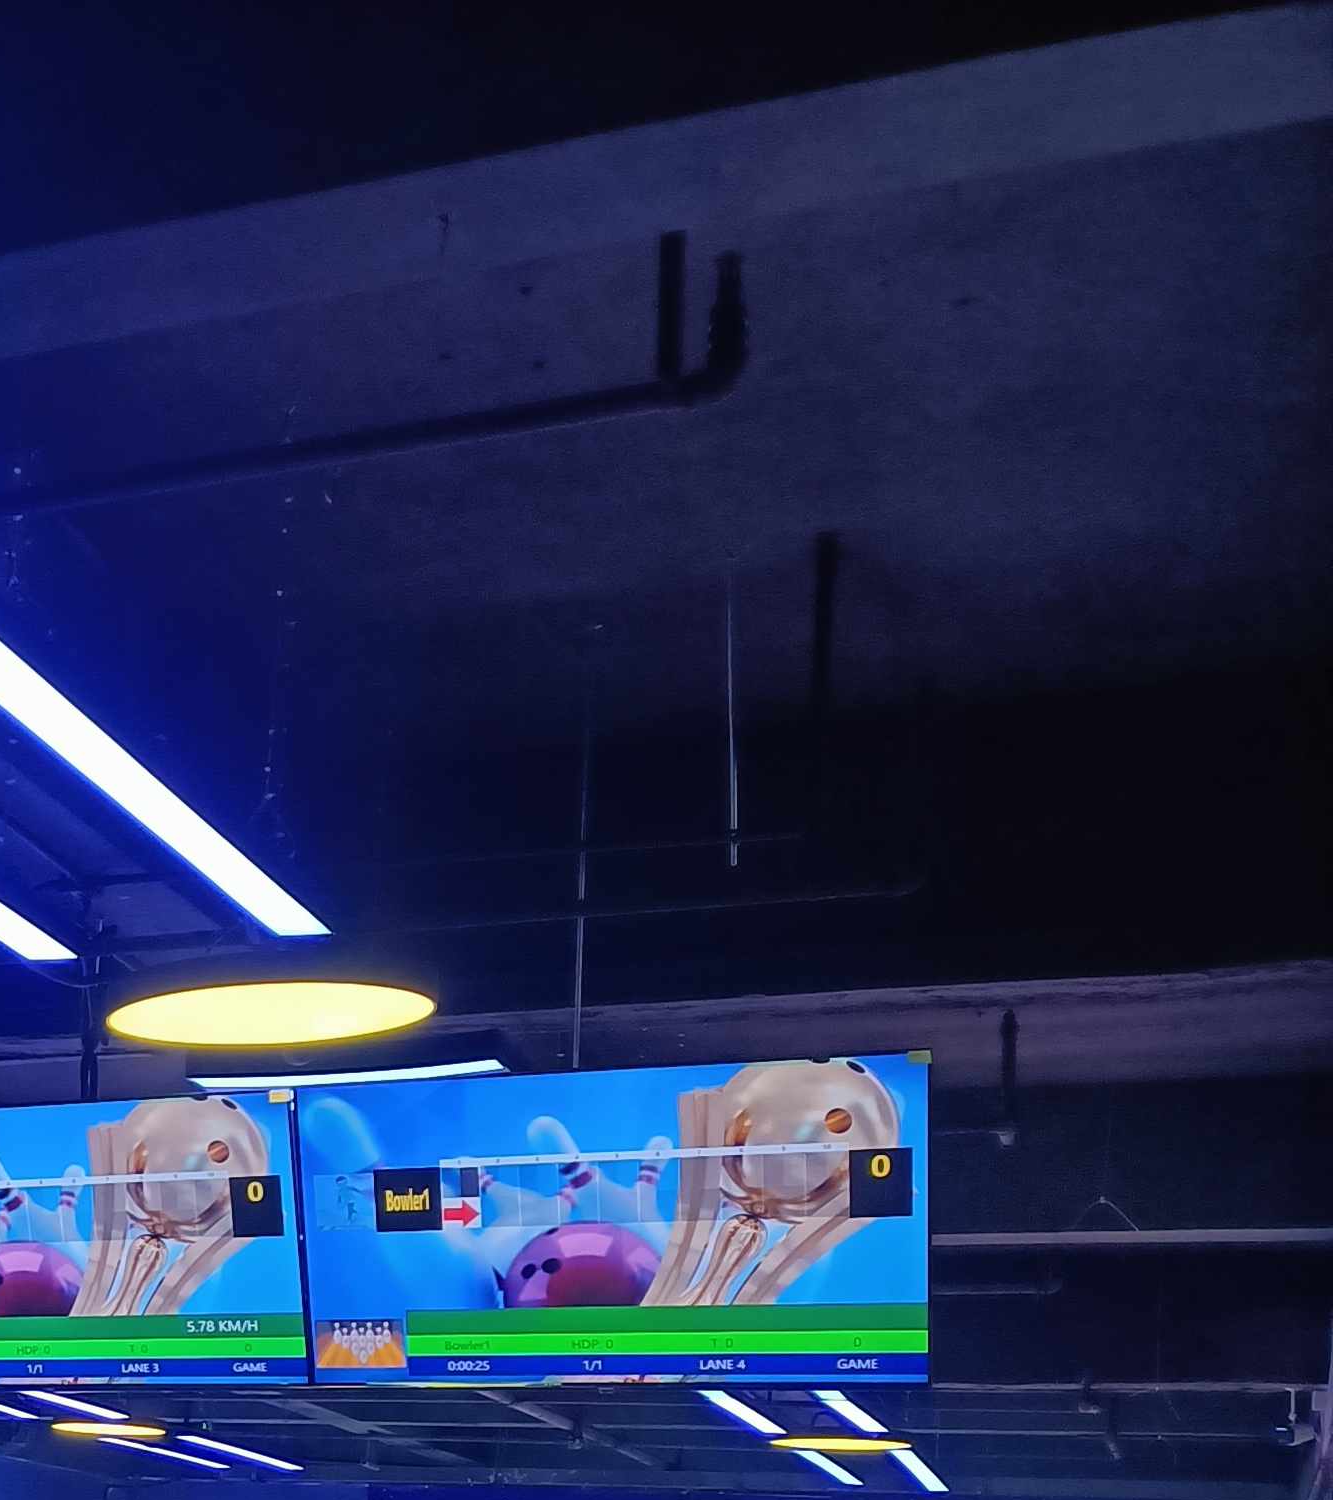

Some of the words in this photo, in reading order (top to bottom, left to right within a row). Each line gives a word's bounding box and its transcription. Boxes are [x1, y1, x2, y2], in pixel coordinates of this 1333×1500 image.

[870, 1154, 891, 1178] 0
[247, 1181, 264, 1203] 0
[384, 1187, 430, 1213] Bowler1
[186, 1320, 215, 1333] 5.78
[218, 1319, 259, 1333] KM/H
[27, 1364, 44, 1374] 1/1
[121, 1363, 150, 1374] LANE
[152, 1363, 160, 1374] 3
[233, 1362, 268, 1373] GAME
[447, 1360, 491, 1372] 0:00:25
[582, 1360, 602, 1371] 1/1
[699, 1359, 734, 1370] LANE
[736, 1359, 746, 1370] 4
[836, 1358, 879, 1370] GAME
